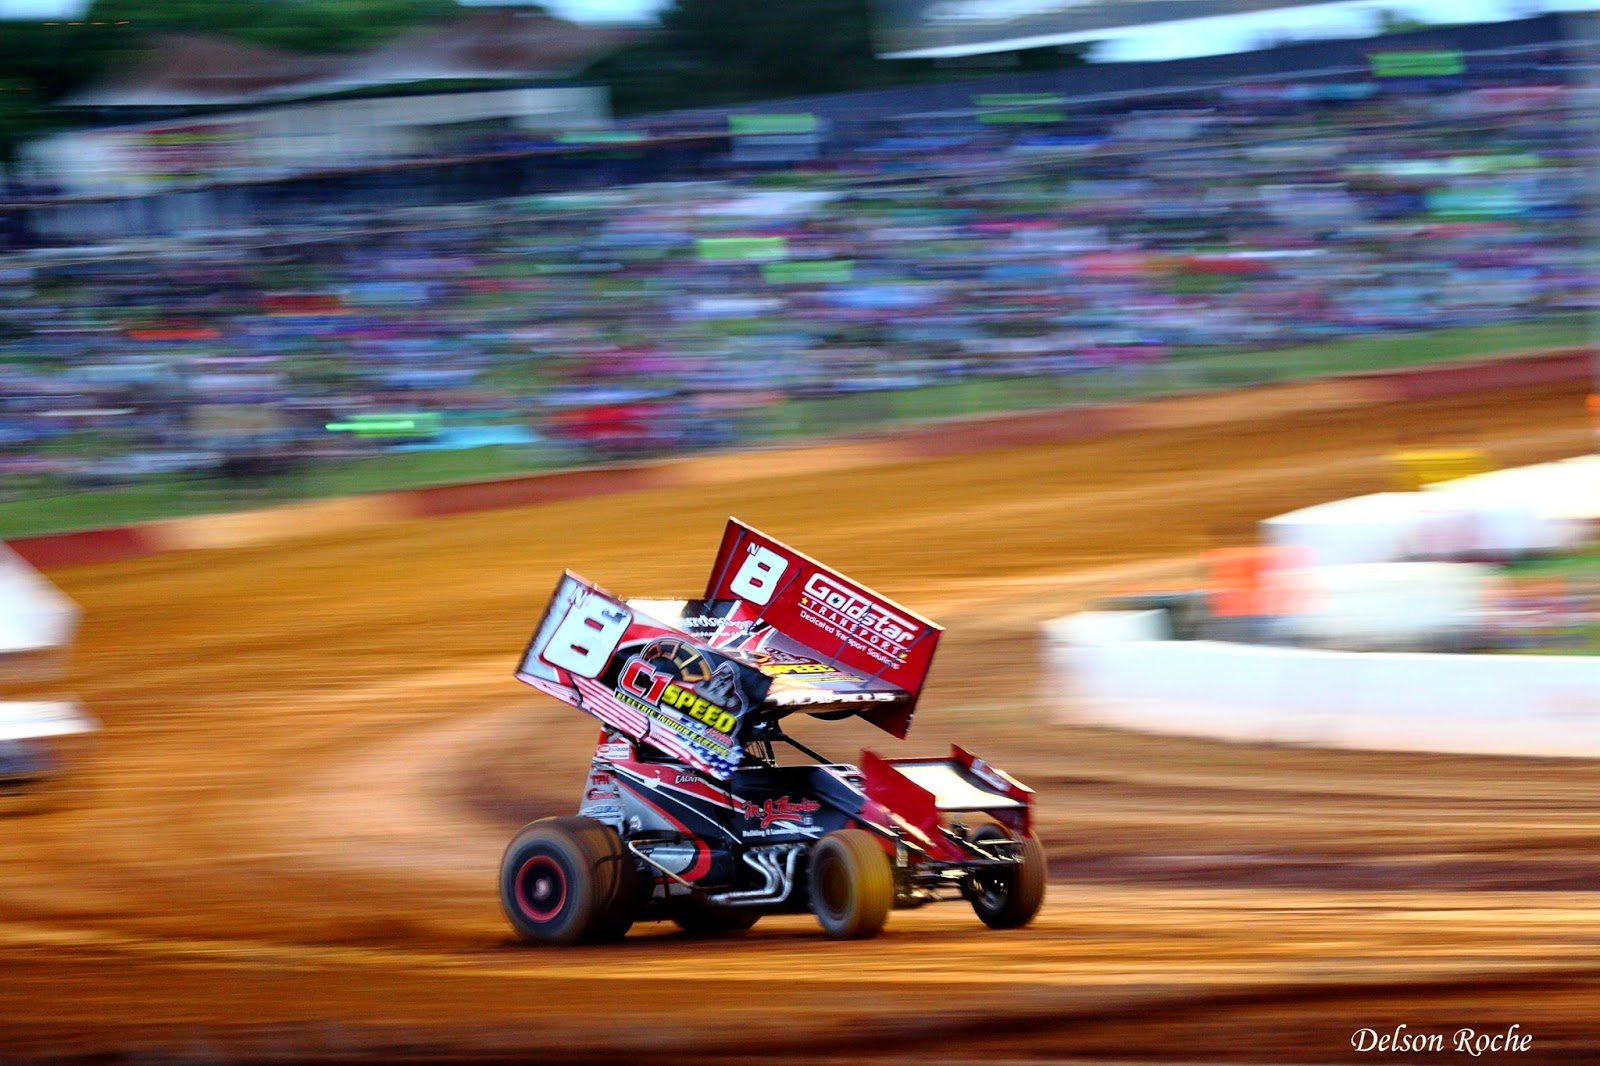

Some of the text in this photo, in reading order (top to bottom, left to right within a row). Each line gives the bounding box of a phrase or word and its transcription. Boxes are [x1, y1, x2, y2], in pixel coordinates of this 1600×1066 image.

[729, 546, 789, 606] 8
[747, 541, 758, 556] N
[540, 590, 634, 680] 8
[800, 610, 834, 634] Dedicated
[835, 629, 867, 652] Transport
[804, 573, 919, 643] Goldstar
[809, 601, 901, 655] TRANSPORT
[615, 691, 656, 717] ELECTRIC
[656, 713, 691, 736] INDOOR
[689, 732, 731, 758] KARTING
[660, 684, 737, 734] SPEED
